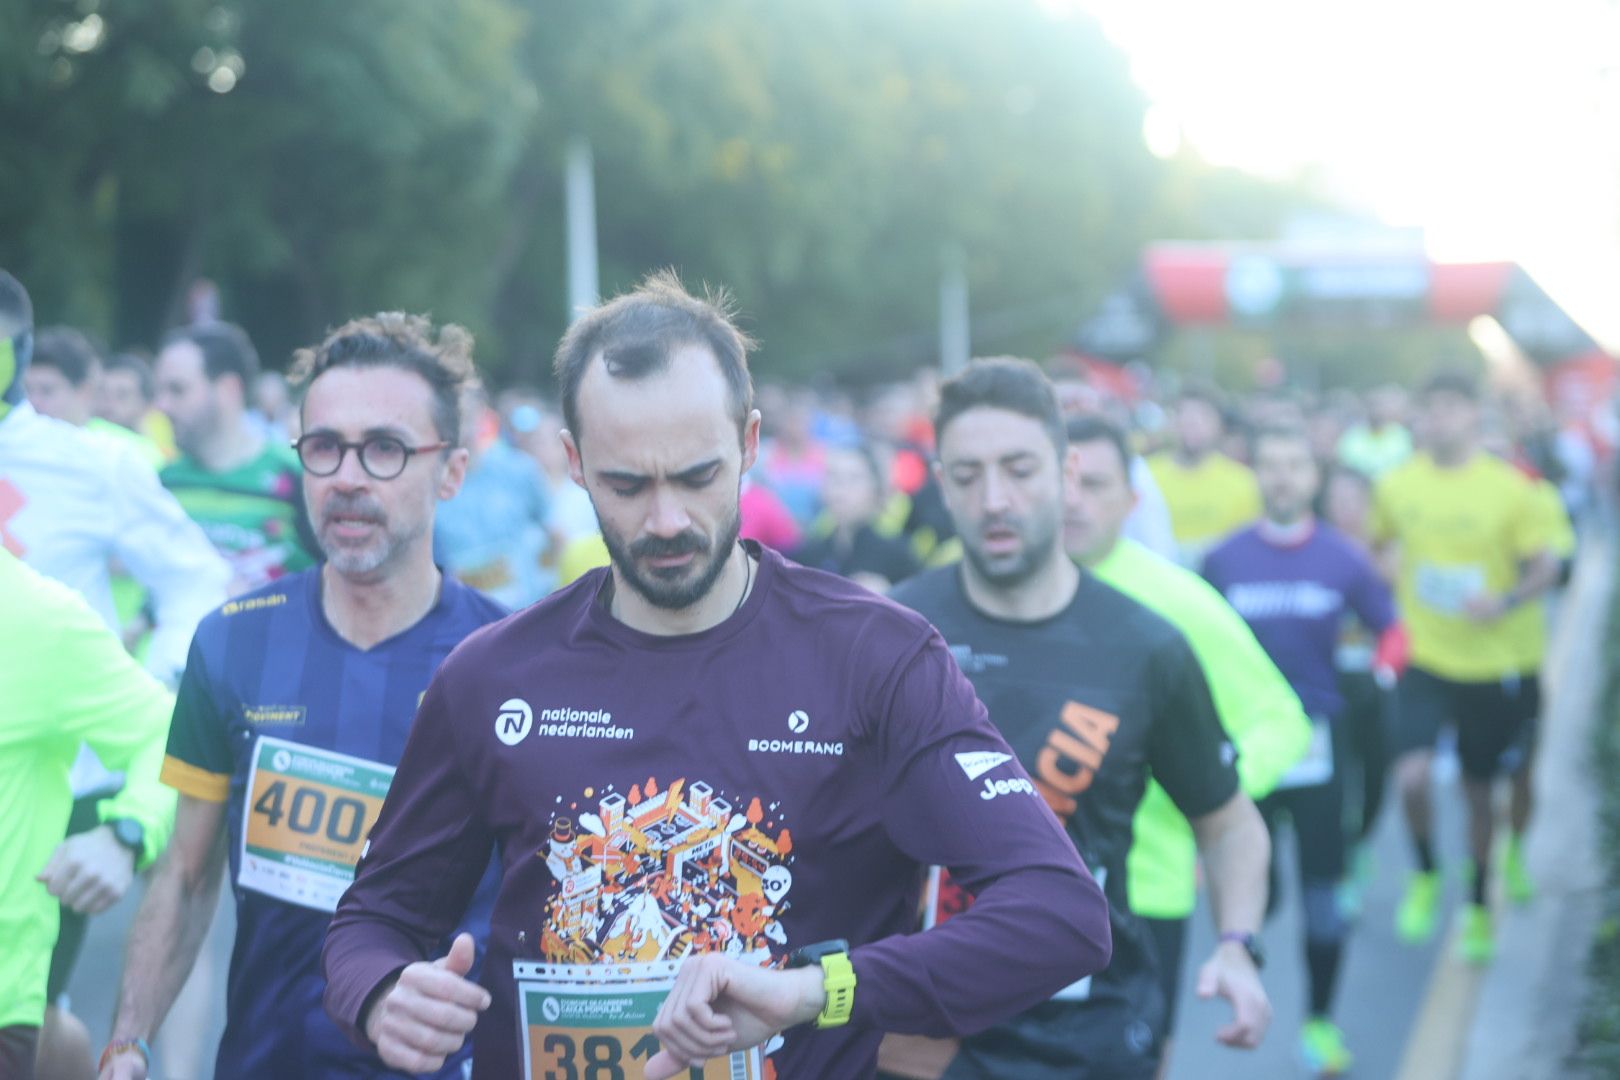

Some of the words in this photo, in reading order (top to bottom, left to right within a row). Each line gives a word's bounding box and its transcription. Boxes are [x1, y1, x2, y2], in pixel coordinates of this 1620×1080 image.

[541, 707, 612, 725] nationale
[538, 722, 634, 740] nederlanden
[748, 738, 844, 756] BOOMERANG
[254, 780, 367, 845] 400
[585, 1005, 623, 1013] POPULAR
